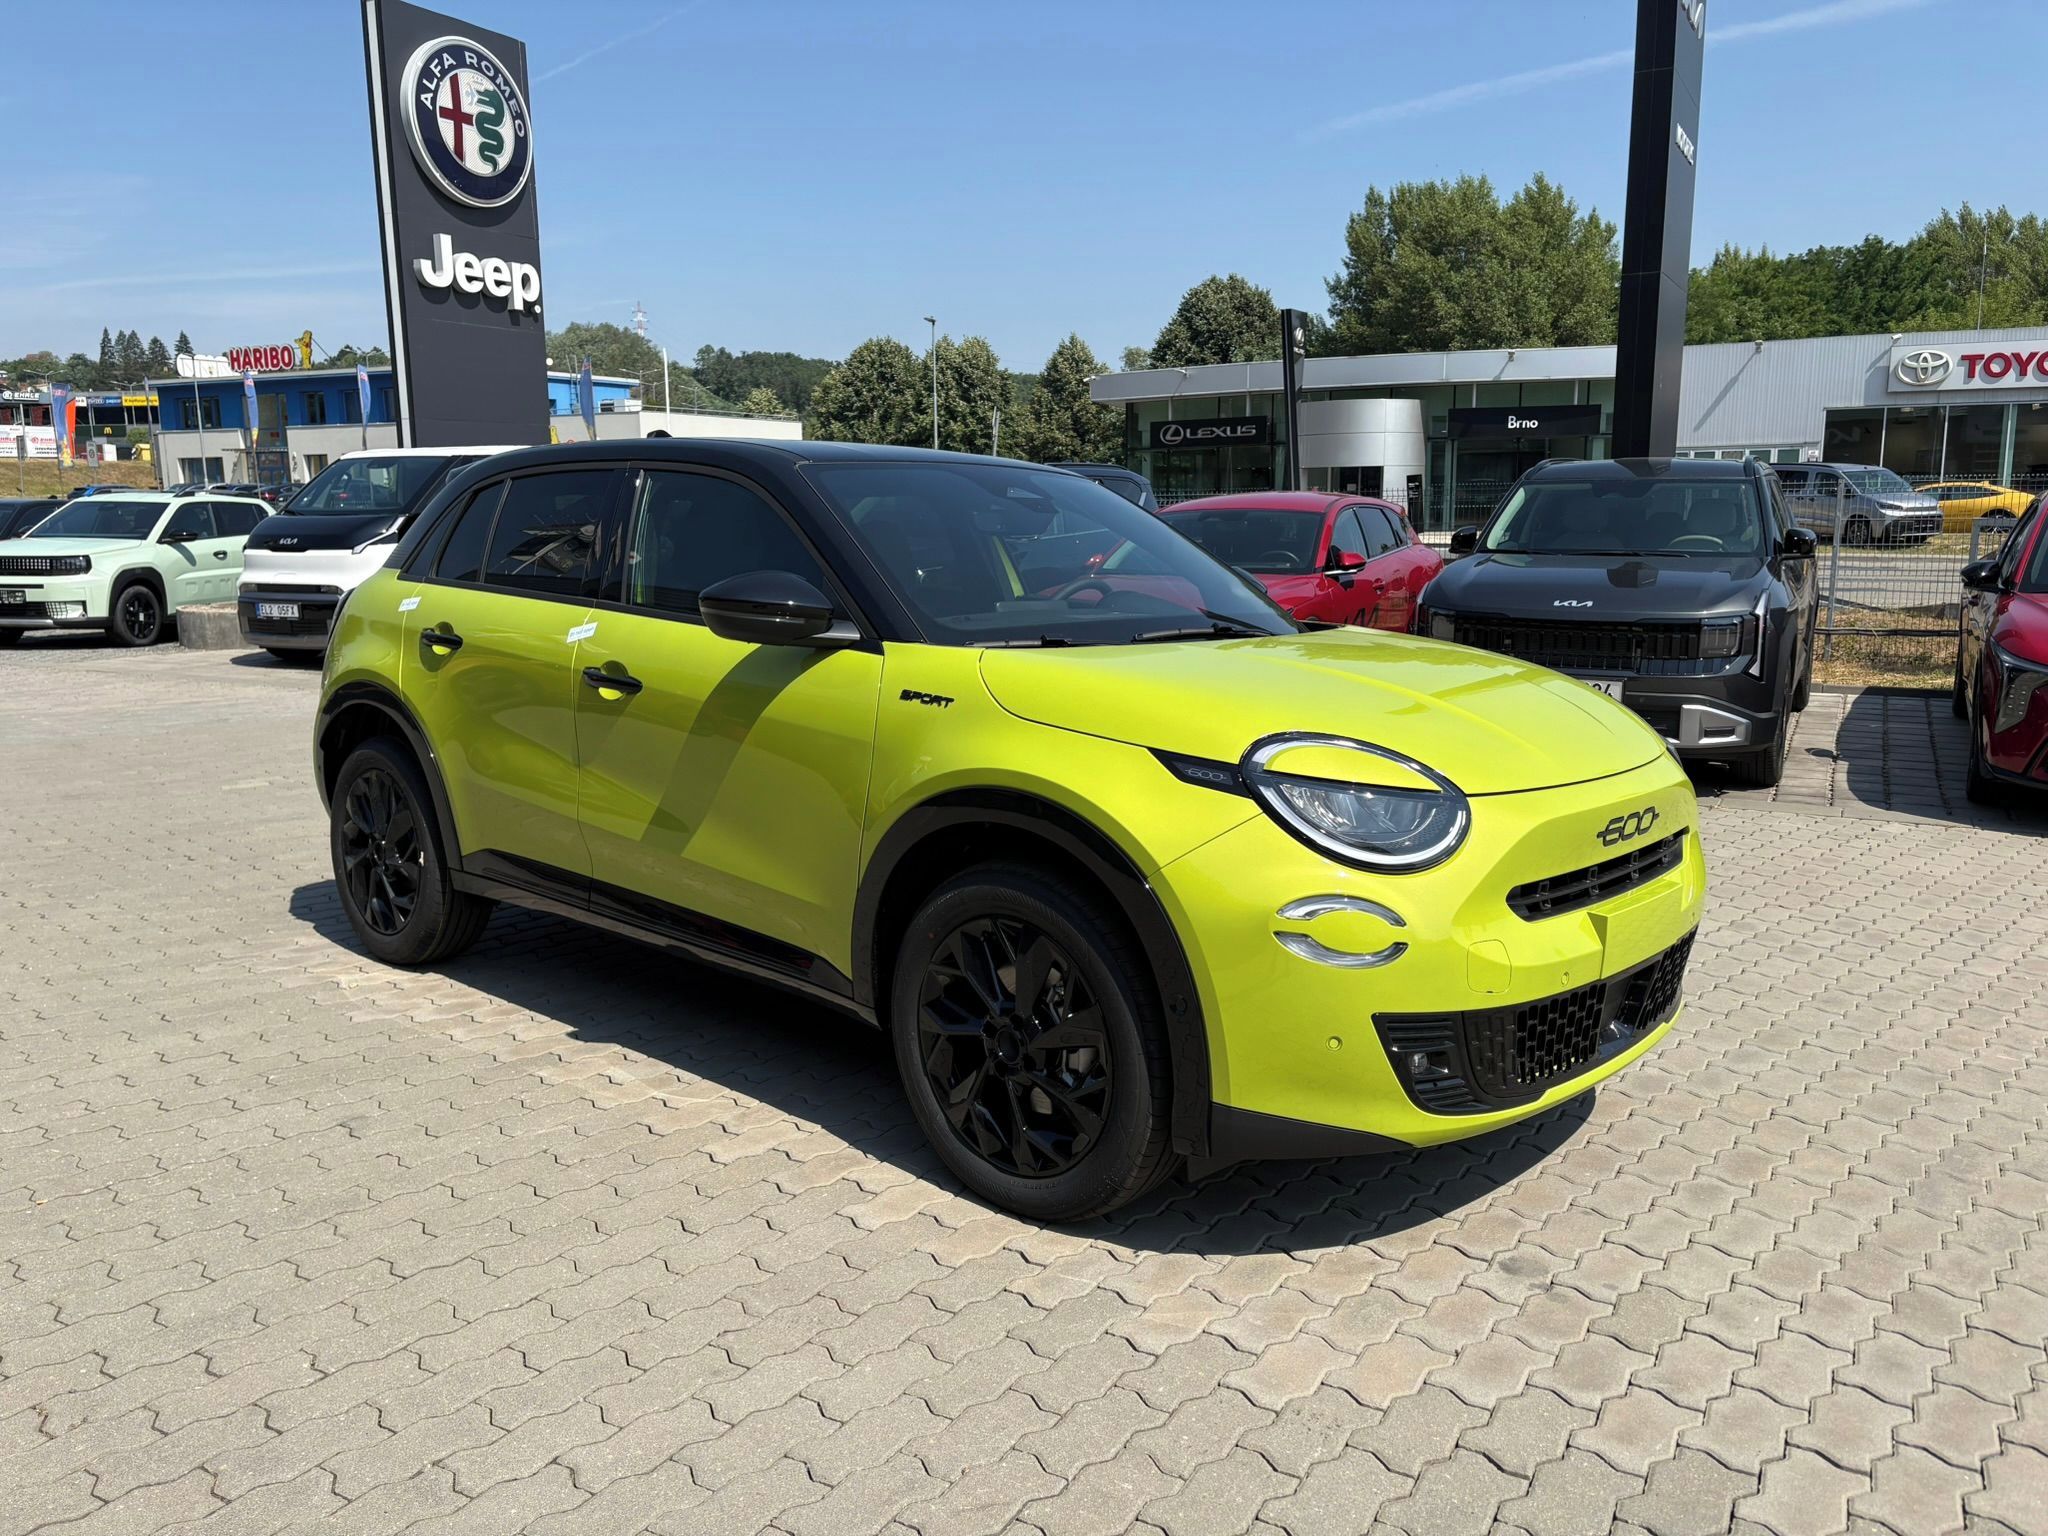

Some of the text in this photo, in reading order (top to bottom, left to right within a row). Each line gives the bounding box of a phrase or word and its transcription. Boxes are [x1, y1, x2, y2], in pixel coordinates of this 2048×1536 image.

[420, 51, 525, 138] ALFA ROMEO
[229, 344, 294, 372] HARIBO
[1185, 424, 1257, 439] LEXUS
[1507, 415, 1539, 429] Brno
[1553, 599, 1593, 608] KIA
[899, 689, 955, 709] SPORT
[1597, 806, 1658, 847] 600
